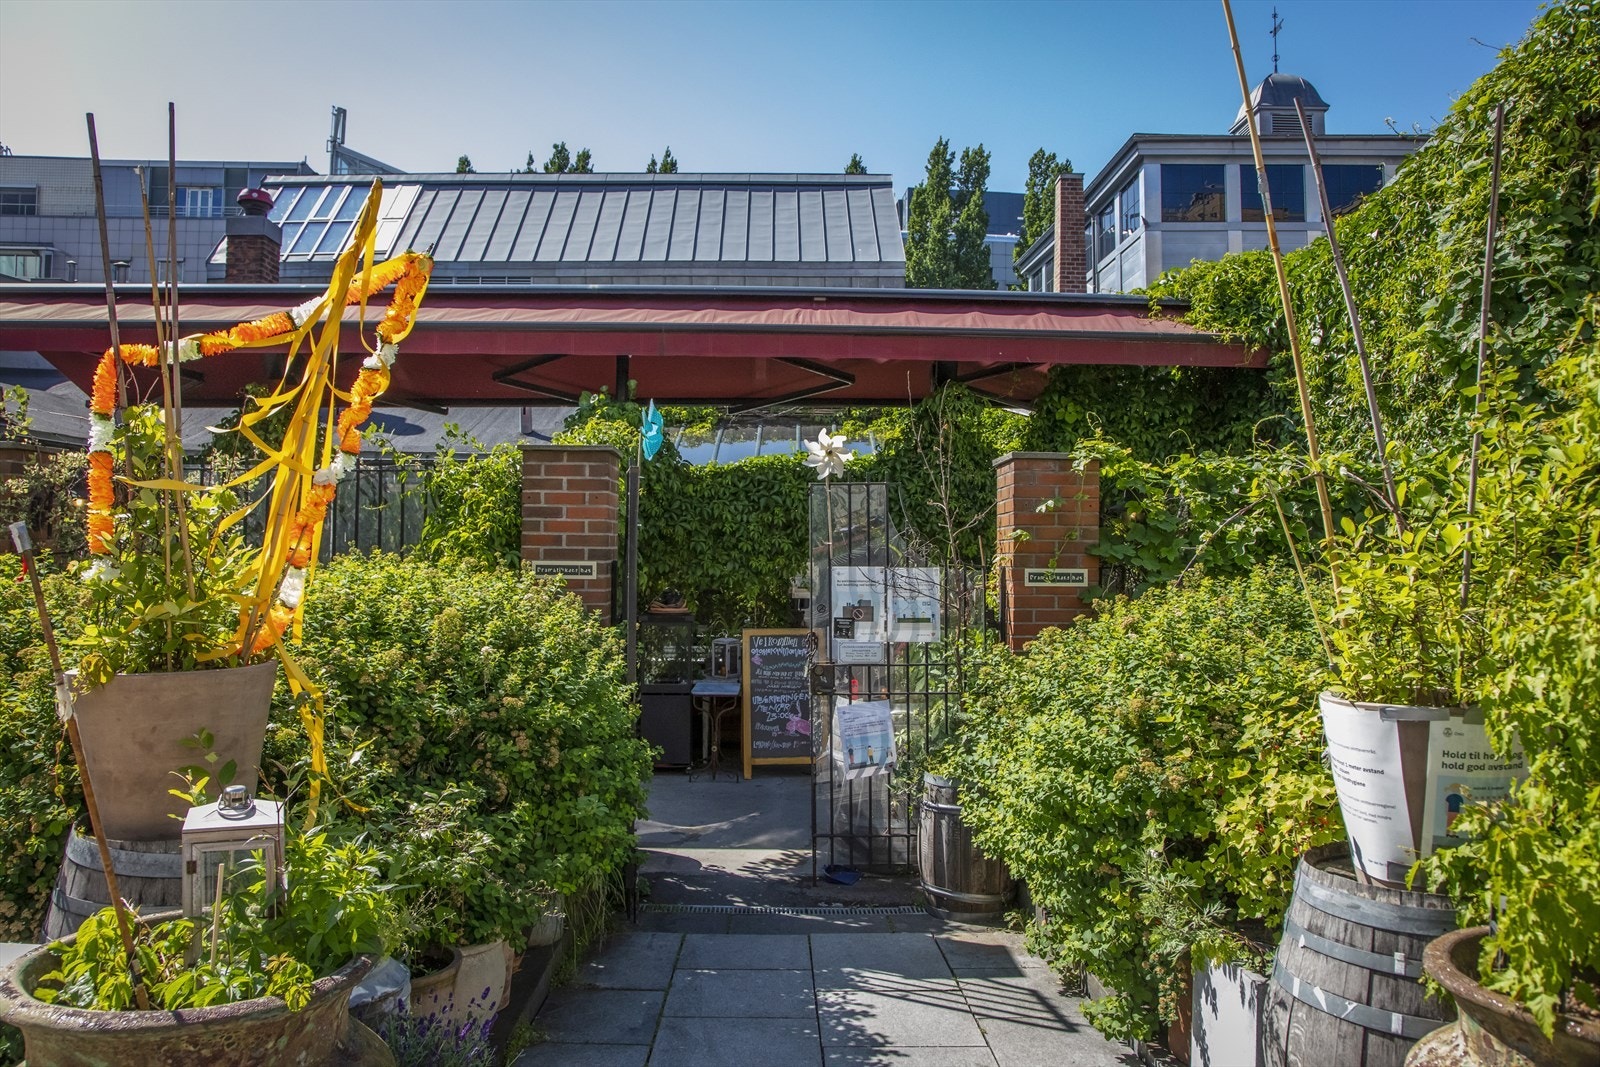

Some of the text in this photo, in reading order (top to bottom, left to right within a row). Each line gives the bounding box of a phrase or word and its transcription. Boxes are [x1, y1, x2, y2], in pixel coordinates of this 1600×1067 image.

[1442, 750, 1467, 760] Hold
[1469, 751, 1481, 760] til
[1362, 766, 1385, 775] avstand
[1441, 761, 1524, 773] hold god avstand
